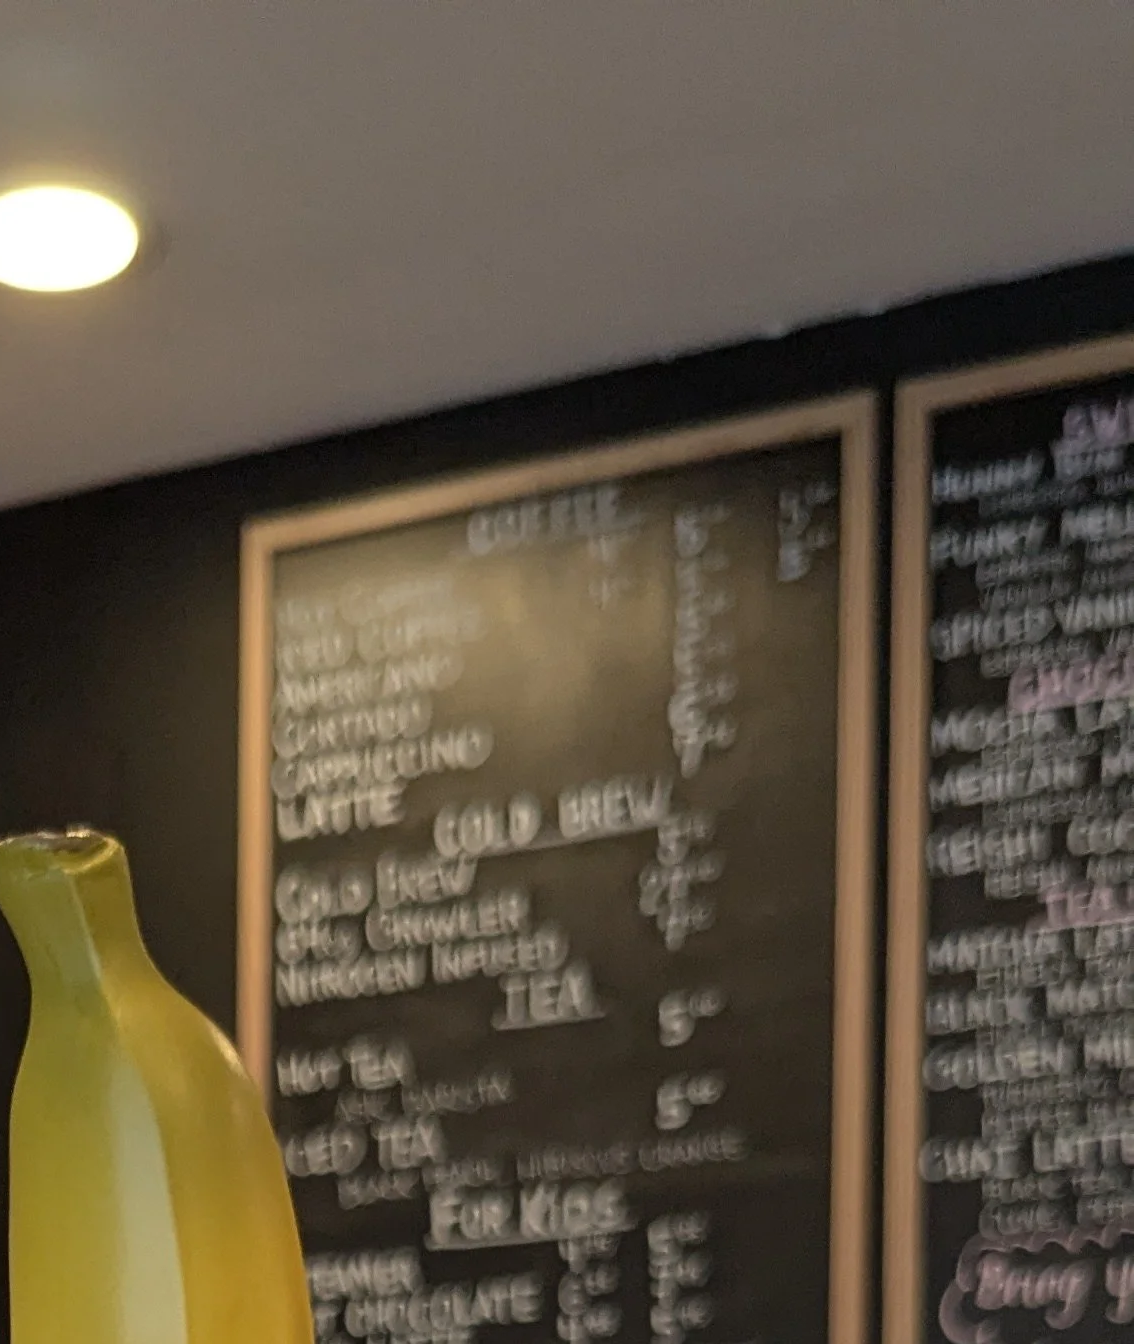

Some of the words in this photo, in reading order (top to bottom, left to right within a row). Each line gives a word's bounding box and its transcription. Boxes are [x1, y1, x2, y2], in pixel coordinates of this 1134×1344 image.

[277, 784, 406, 841] LATTE
[436, 794, 541, 856] COLD
[559, 776, 672, 838] BREW
[277, 864, 372, 920] COLD
[377, 854, 478, 905] BREW
[367, 888, 528, 950] GROWLER
[504, 964, 596, 1022] TEA
[277, 1050, 342, 1096] HOT
[345, 1038, 415, 1090] TEA
[284, 1124, 366, 1176] CED
[372, 1112, 446, 1168] TEA
[429, 1186, 516, 1243] FOR
[520, 1178, 632, 1233] KIDS
[345, 1274, 542, 1337] CHOCOLATE
